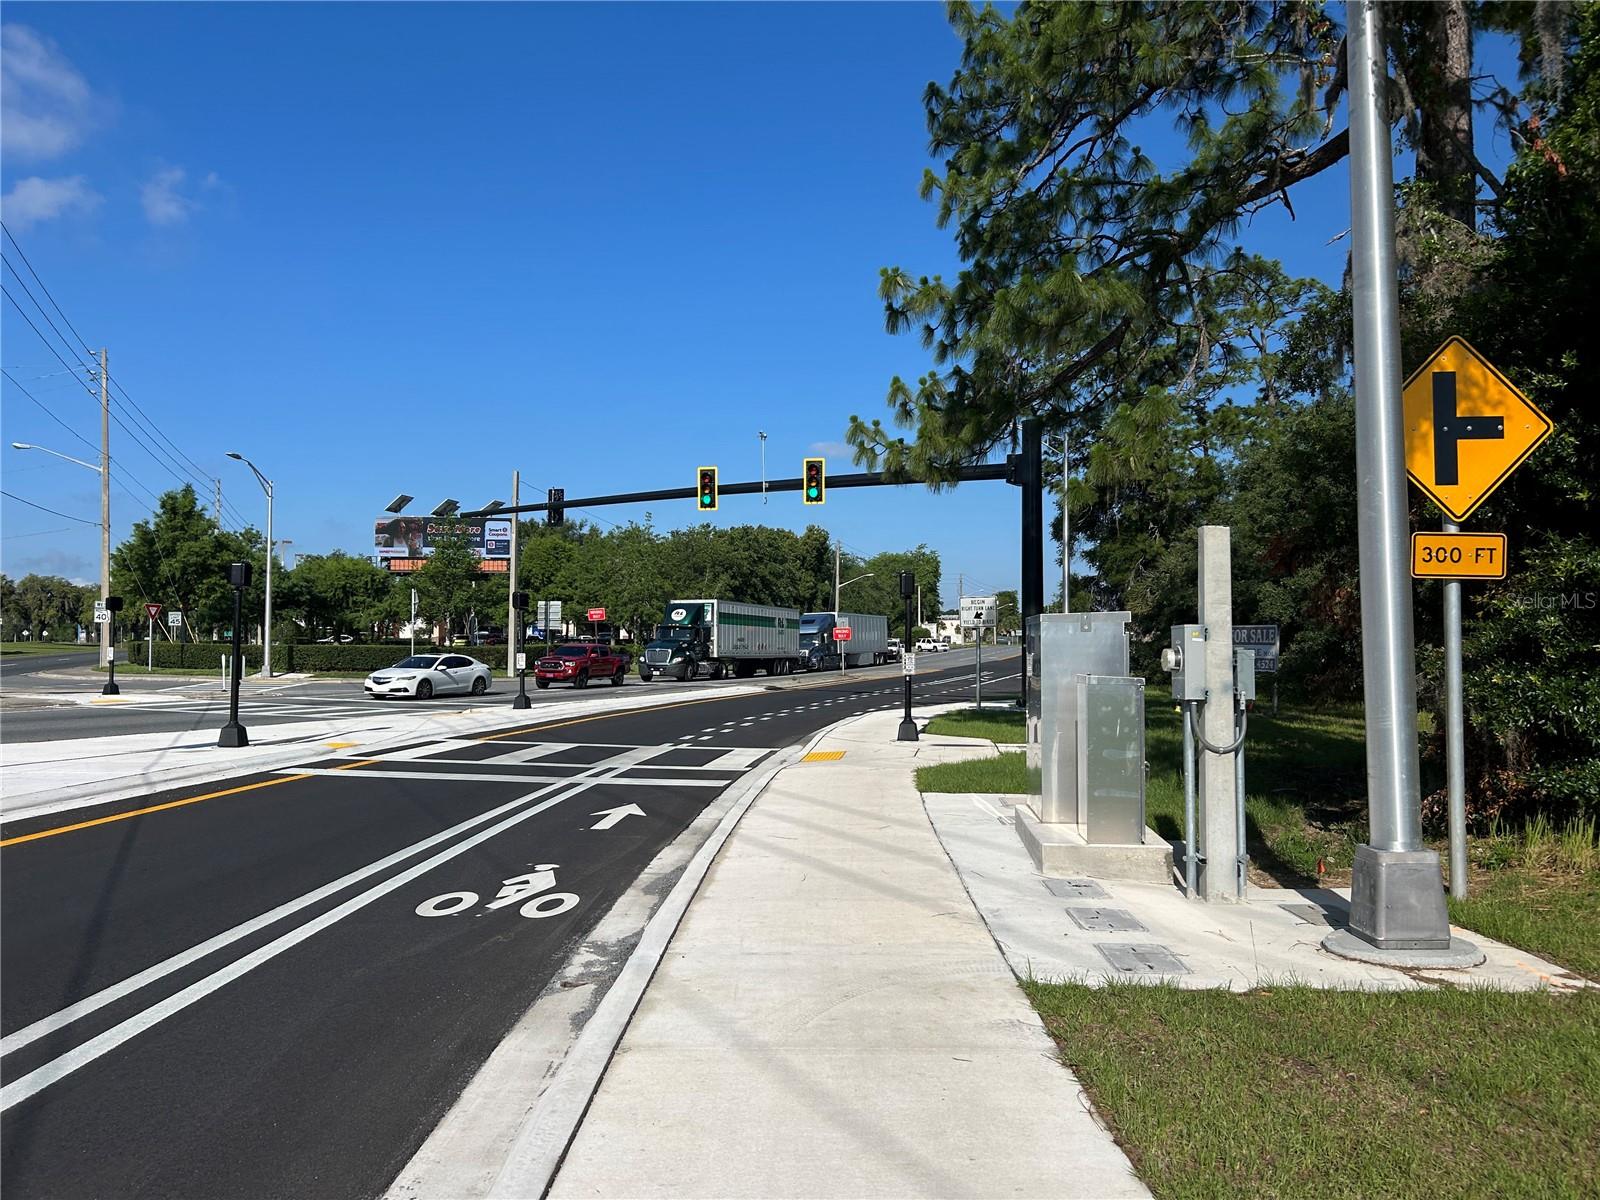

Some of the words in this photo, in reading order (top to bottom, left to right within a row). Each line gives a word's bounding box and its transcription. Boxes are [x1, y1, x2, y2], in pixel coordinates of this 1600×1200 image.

[1422, 546, 1462, 563] 300
[1475, 547, 1497, 564] FT
[1232, 629, 1248, 643] OR
[1249, 629, 1275, 643] SALE
